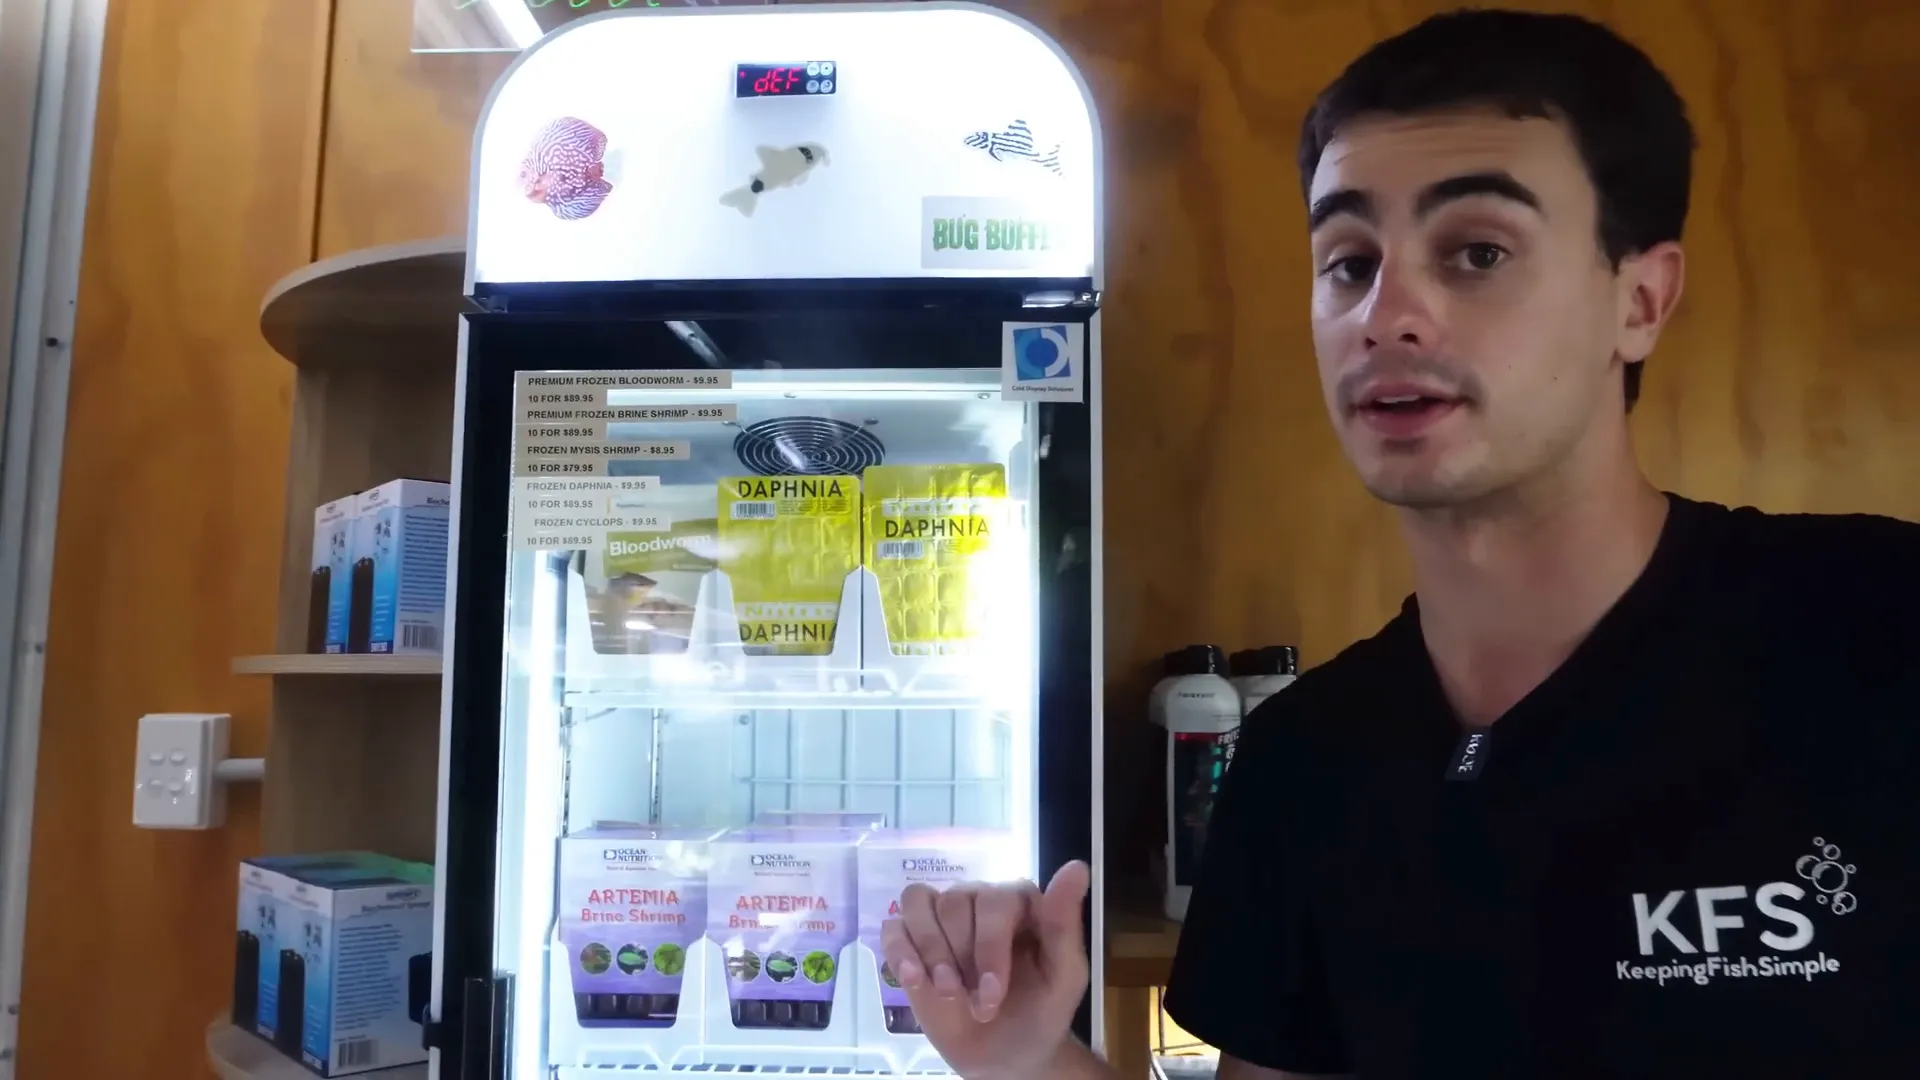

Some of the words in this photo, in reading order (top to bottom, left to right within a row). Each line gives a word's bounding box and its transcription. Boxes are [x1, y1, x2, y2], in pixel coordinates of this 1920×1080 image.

[932, 217, 979, 251] BUG
[528, 377, 574, 386] PREMIUM
[576, 377, 616, 386] FROZEN
[618, 376, 684, 385] BLOODWORM
[693, 376, 718, 384] $9.95
[528, 395, 538, 403] 10
[541, 394, 561, 403] FOR
[564, 394, 594, 403] $89.95
[527, 410, 572, 419] PREMIUM
[575, 410, 616, 418] FROZEN
[618, 410, 648, 418] BRINE
[650, 409, 688, 418] SHRIMP
[698, 408, 723, 418] $9.95
[528, 429, 538, 437] 10
[541, 428, 561, 437] FOR
[564, 428, 593, 437] $89.95
[527, 446, 568, 454] FROZEN
[570, 446, 600, 454] MYSIS
[603, 446, 641, 454] SHRIMP
[650, 446, 675, 454] $8.95
[528, 464, 538, 472] 10
[540, 464, 561, 472] FOR
[564, 464, 594, 472] $79.95
[526, 482, 567, 491] FROZEN
[569, 482, 612, 490] DAPHNIA
[621, 482, 646, 490] $9.95
[738, 479, 842, 498] DAPHNIA
[528, 500, 538, 509] 10
[540, 500, 561, 508] FOR
[563, 500, 593, 509] $89.95
[534, 518, 573, 526] FROZEN
[576, 518, 624, 526] CYCLOPS
[632, 517, 657, 526] $9.95
[884, 518, 989, 538] DAPHNIA
[527, 537, 538, 546] 10
[540, 537, 560, 545] FOR
[563, 536, 592, 546] $89.95
[588, 889, 680, 905] ARTEMIA
[736, 895, 828, 912] ARTEMIA
[581, 908, 624, 922] Brine
[628, 908, 687, 927] Shrimp
[1631, 881, 1815, 956] KFS
[1616, 952, 1840, 986] KeepingFishSimple
